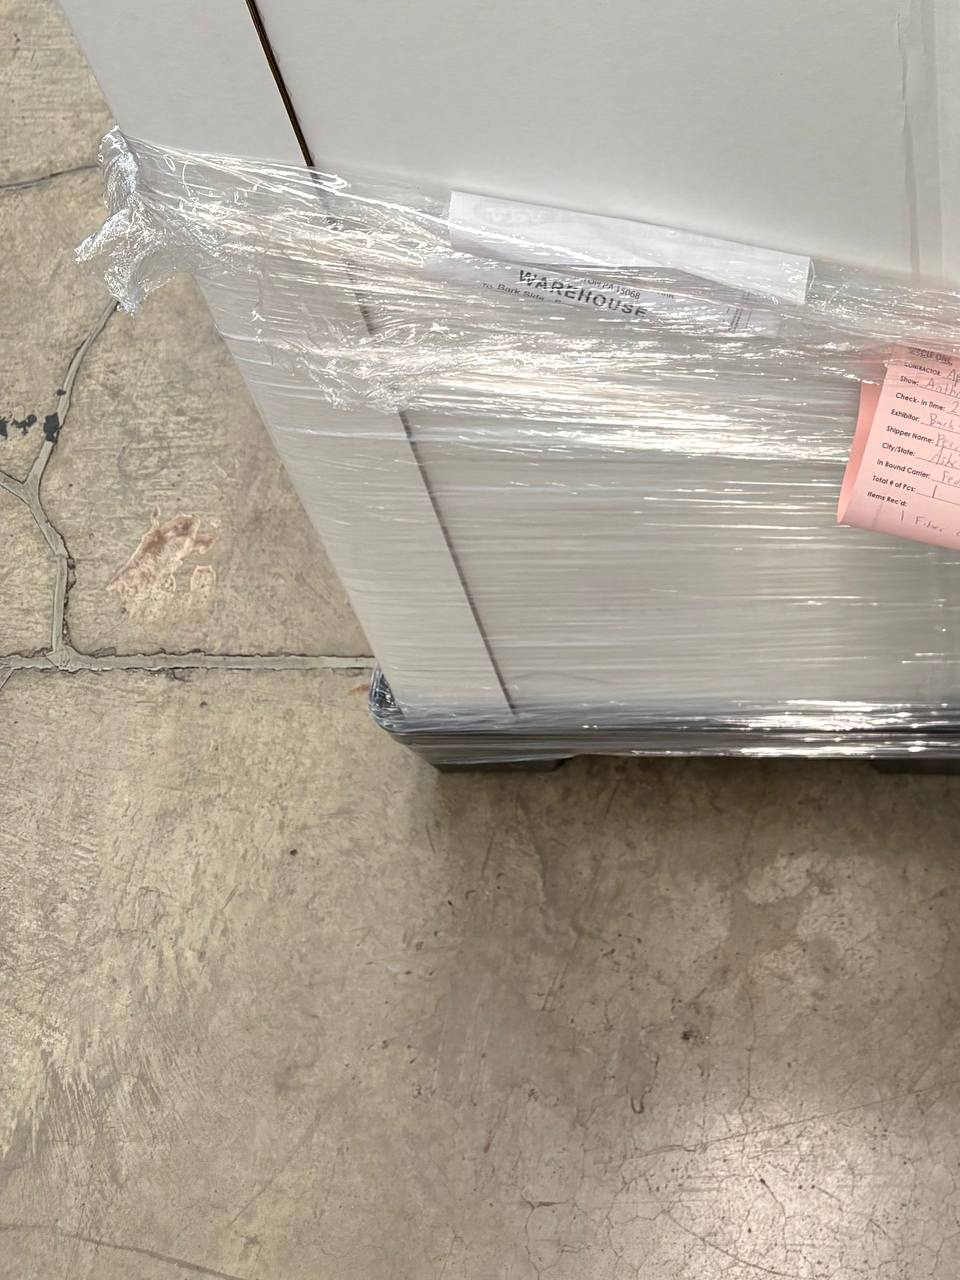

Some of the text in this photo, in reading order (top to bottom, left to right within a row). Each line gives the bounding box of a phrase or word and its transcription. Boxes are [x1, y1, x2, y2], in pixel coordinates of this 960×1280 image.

[519, 269, 649, 318] WAREHOUSE
[616, 285, 641, 300] 15068
[900, 375, 920, 387] Show:
[895, 392, 920, 405] Check-
[928, 400, 946, 412] Time:
[890, 409, 921, 422] Exhibitor:
[886, 425, 935, 445] Shipper Name:
[881, 442, 916, 457] City/State:
[877, 458, 932, 480] In Bound Carrier:
[872, 474, 889, 486] Total
[889, 479, 894, 487] #
[894, 481, 902, 489] of
[867, 491, 886, 503] Items
